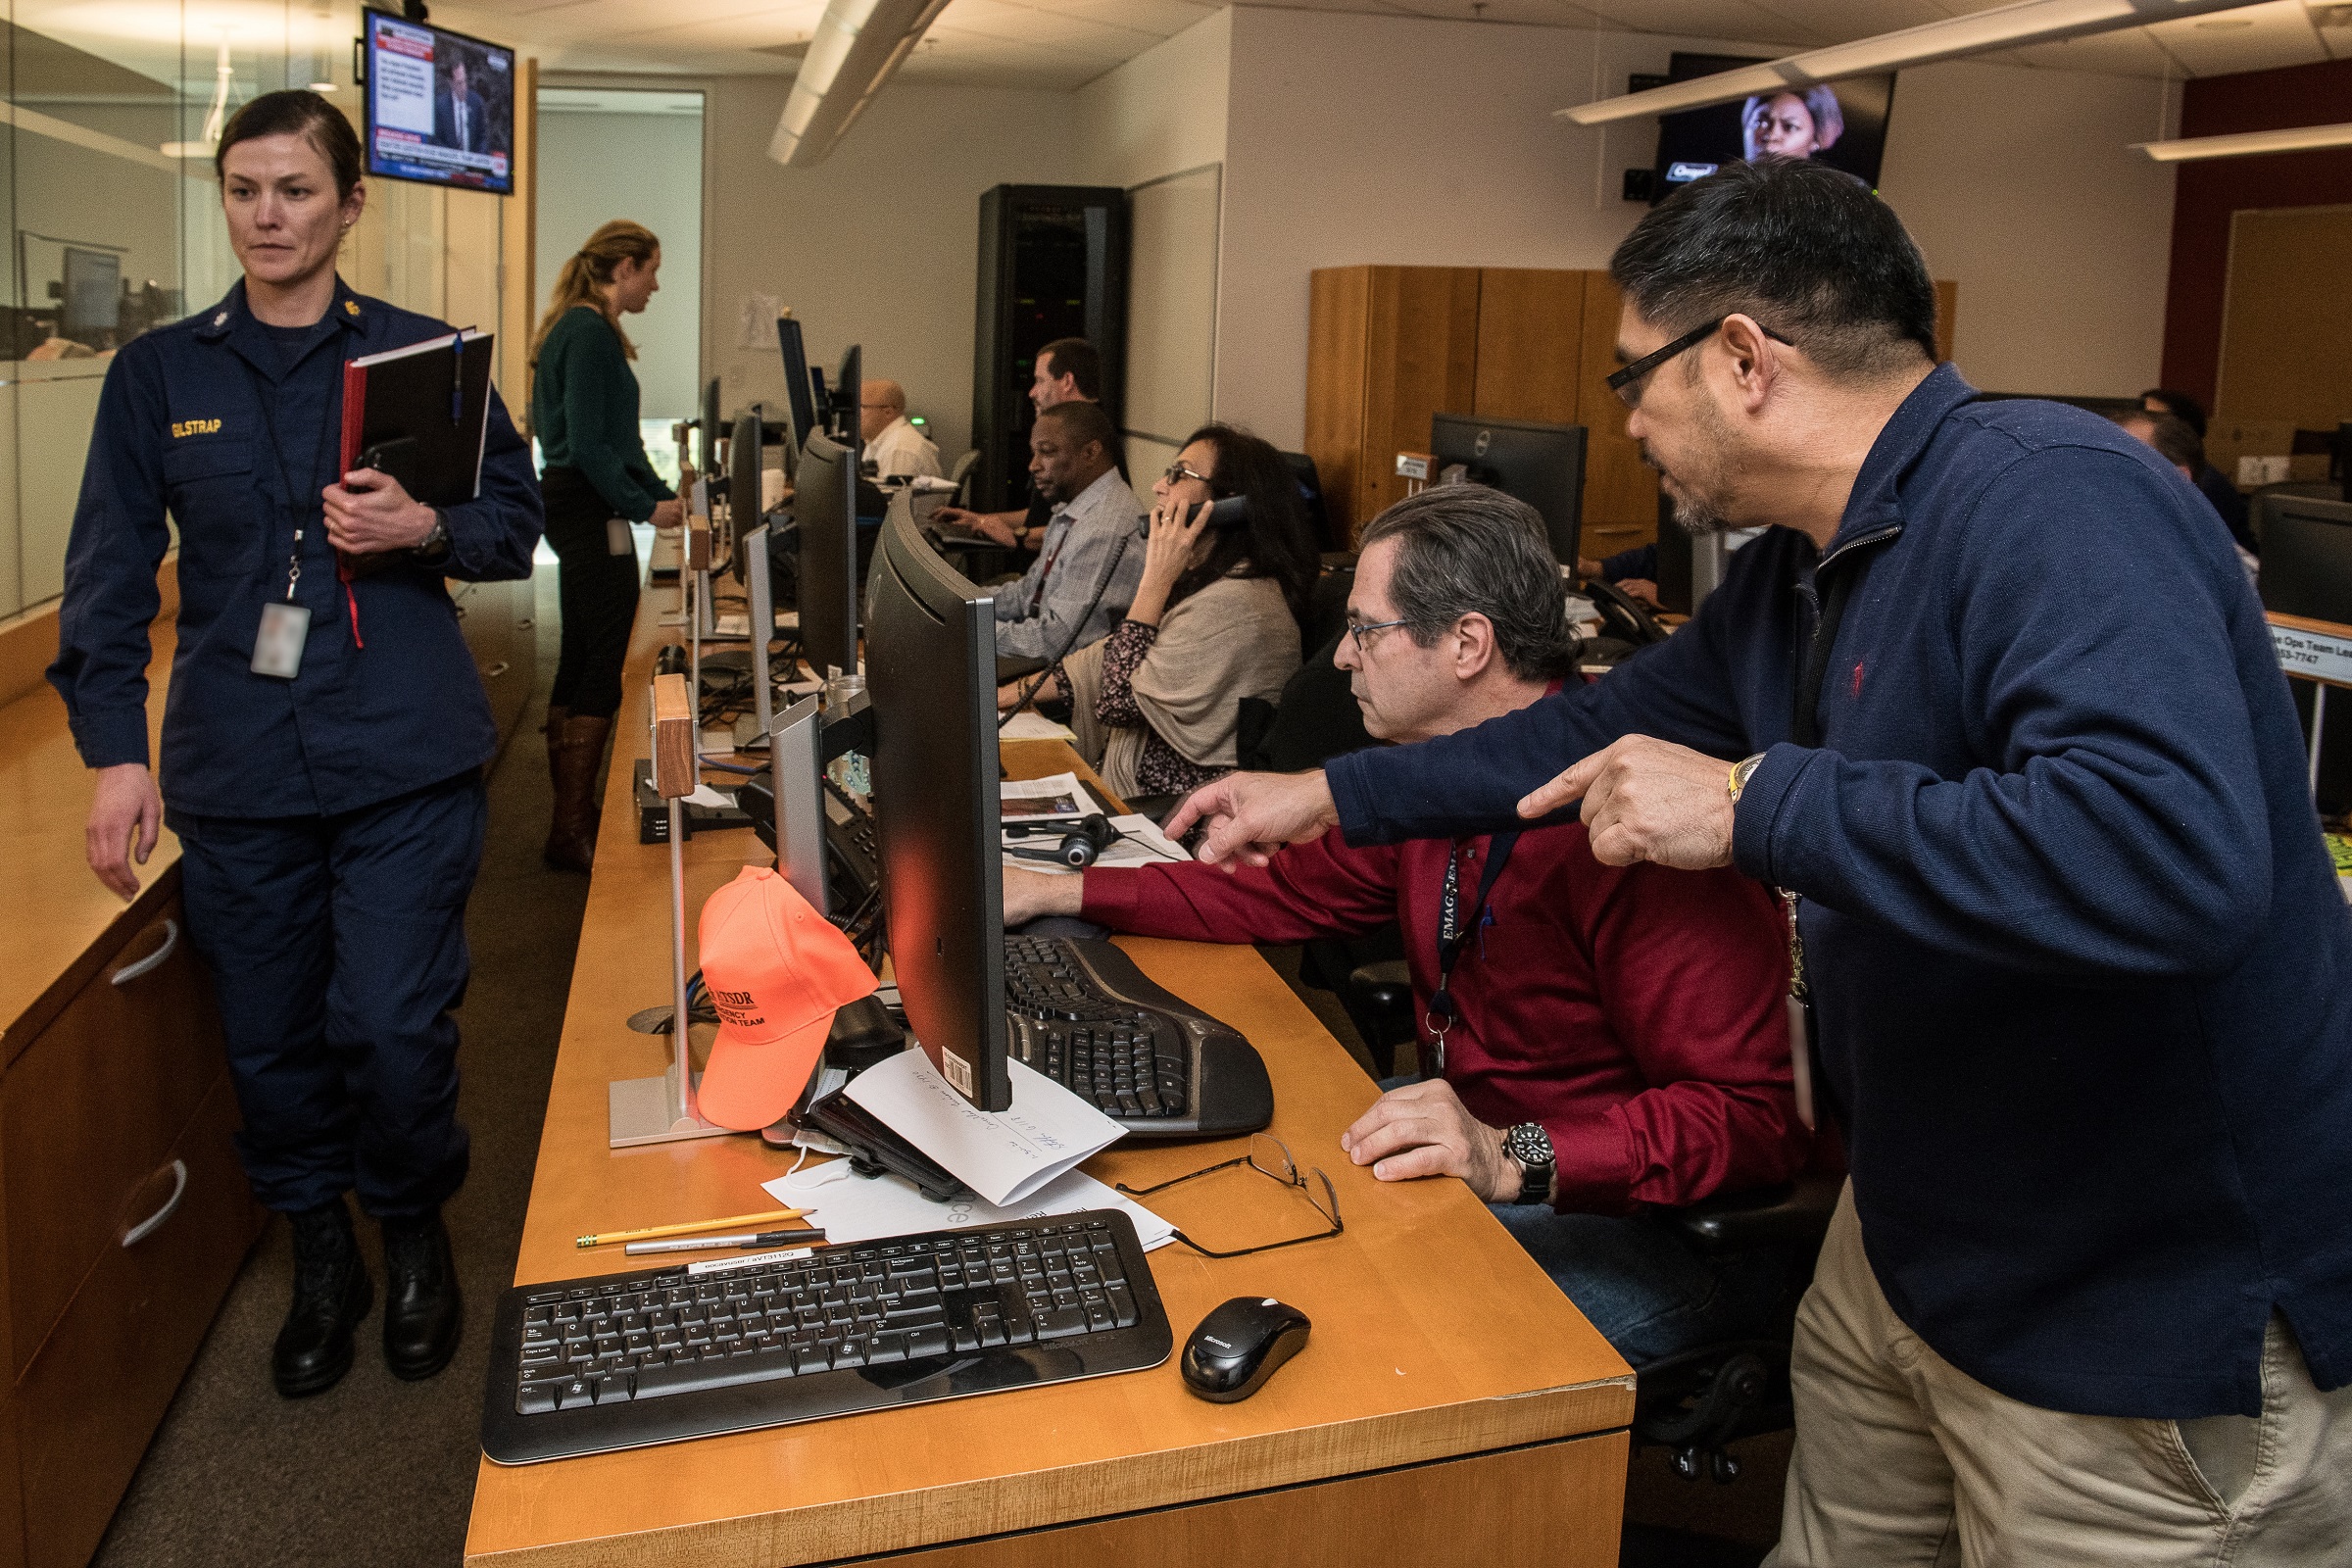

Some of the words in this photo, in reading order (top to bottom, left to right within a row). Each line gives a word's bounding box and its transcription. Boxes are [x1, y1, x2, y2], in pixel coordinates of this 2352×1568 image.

[172, 418, 221, 438] GILSTRAP
[1444, 896, 1454, 940] EMAG
[738, 1017, 765, 1027] TEAM
[1204, 1335, 1232, 1349] Microsoft
